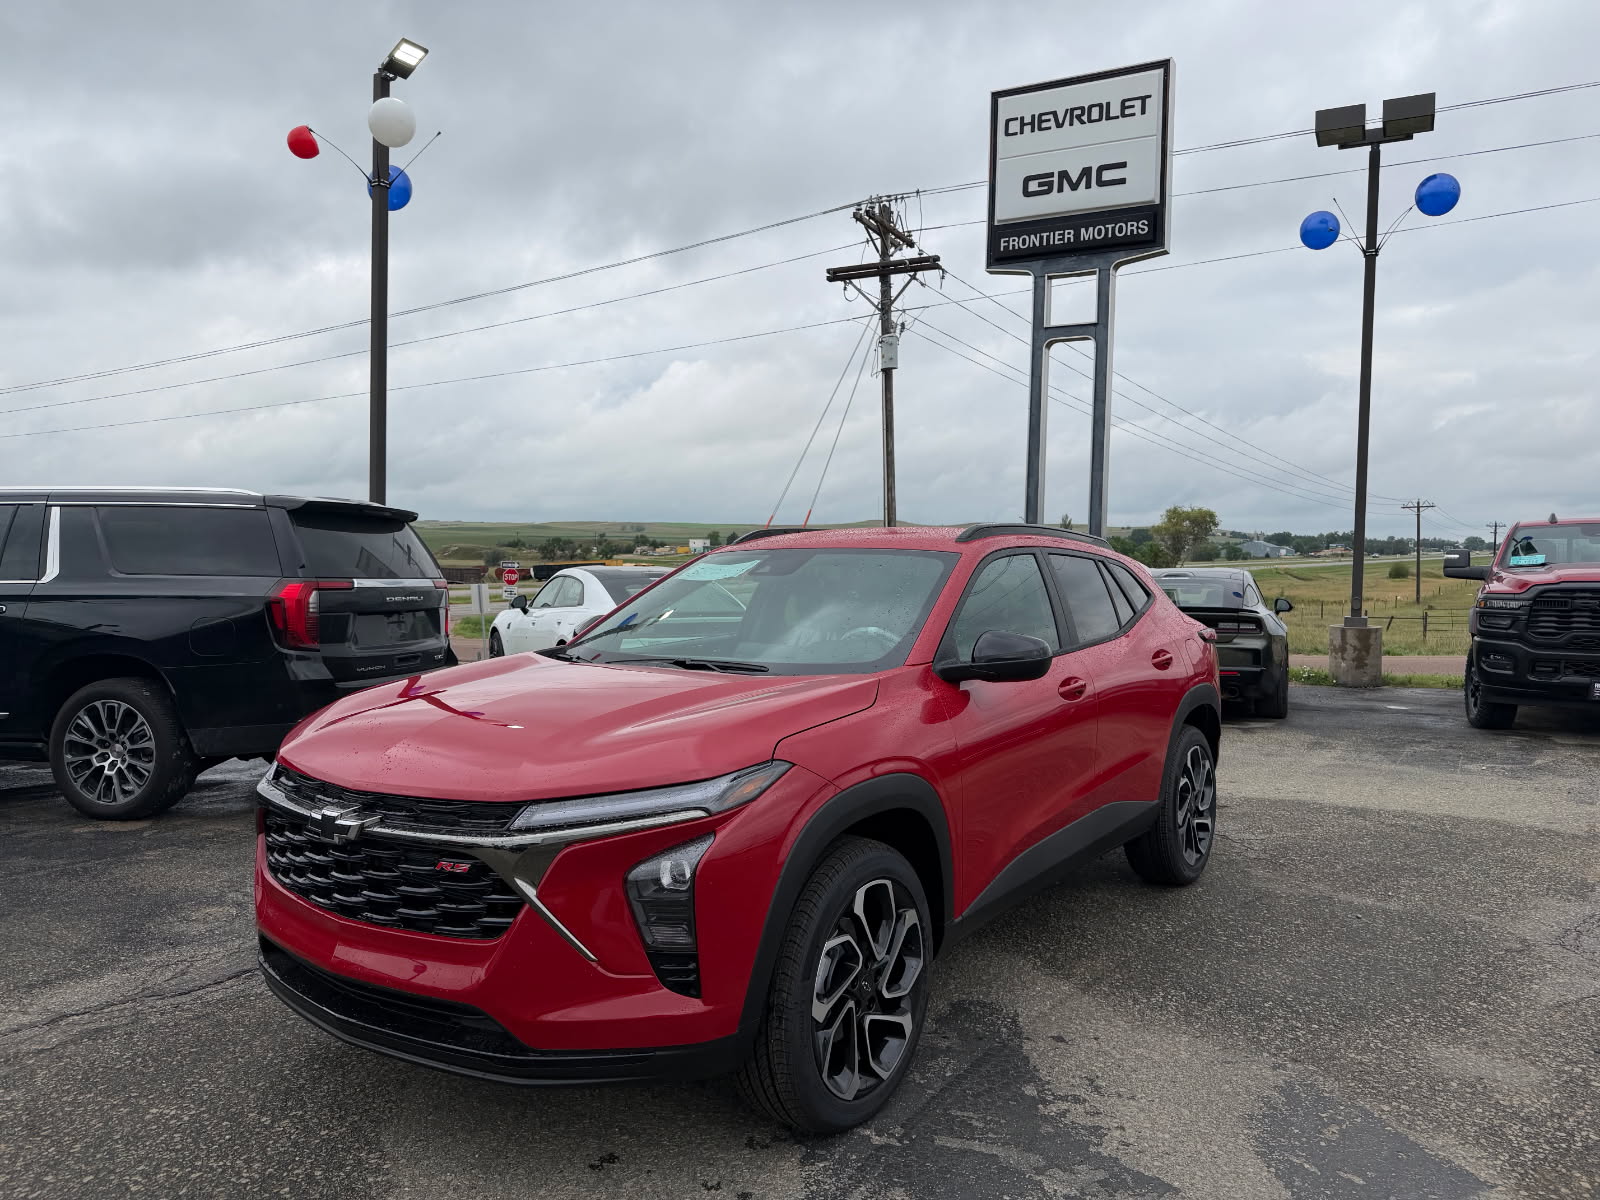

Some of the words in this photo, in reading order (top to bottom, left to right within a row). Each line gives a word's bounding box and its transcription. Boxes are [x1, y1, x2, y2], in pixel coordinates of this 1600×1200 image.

[1004, 94, 1152, 137] CHEVROLET
[1022, 161, 1128, 198] GMC
[1000, 229, 1075, 252] FRONTIER
[1080, 219, 1149, 242] MOTORS
[504, 573, 519, 581] STOP
[435, 861, 471, 872] RS
